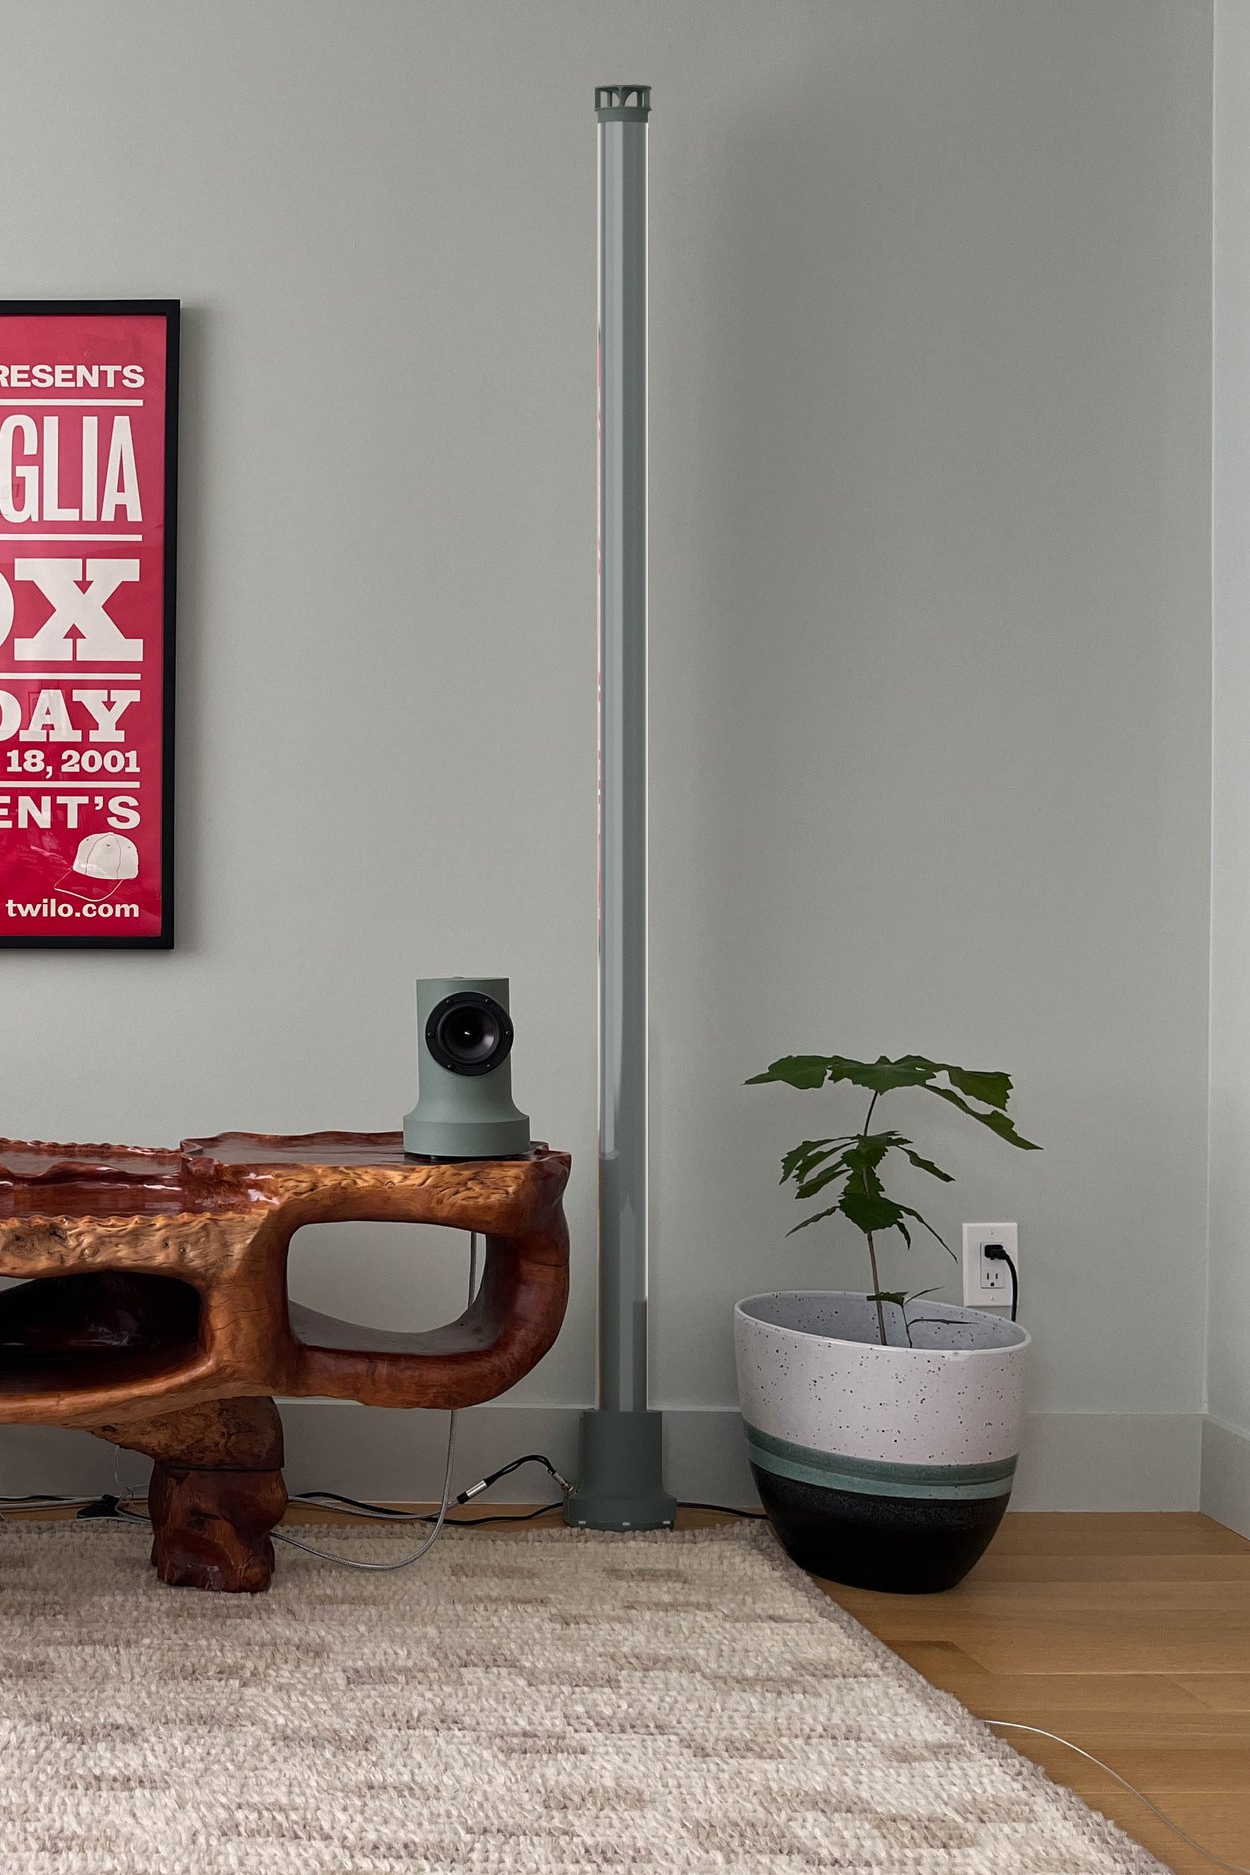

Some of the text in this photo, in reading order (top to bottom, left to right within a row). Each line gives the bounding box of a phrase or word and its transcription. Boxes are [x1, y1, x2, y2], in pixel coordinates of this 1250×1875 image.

[6, 749, 54, 779] 18,
[61, 749, 141, 773] 2001
[5, 897, 140, 918] twilo.com
